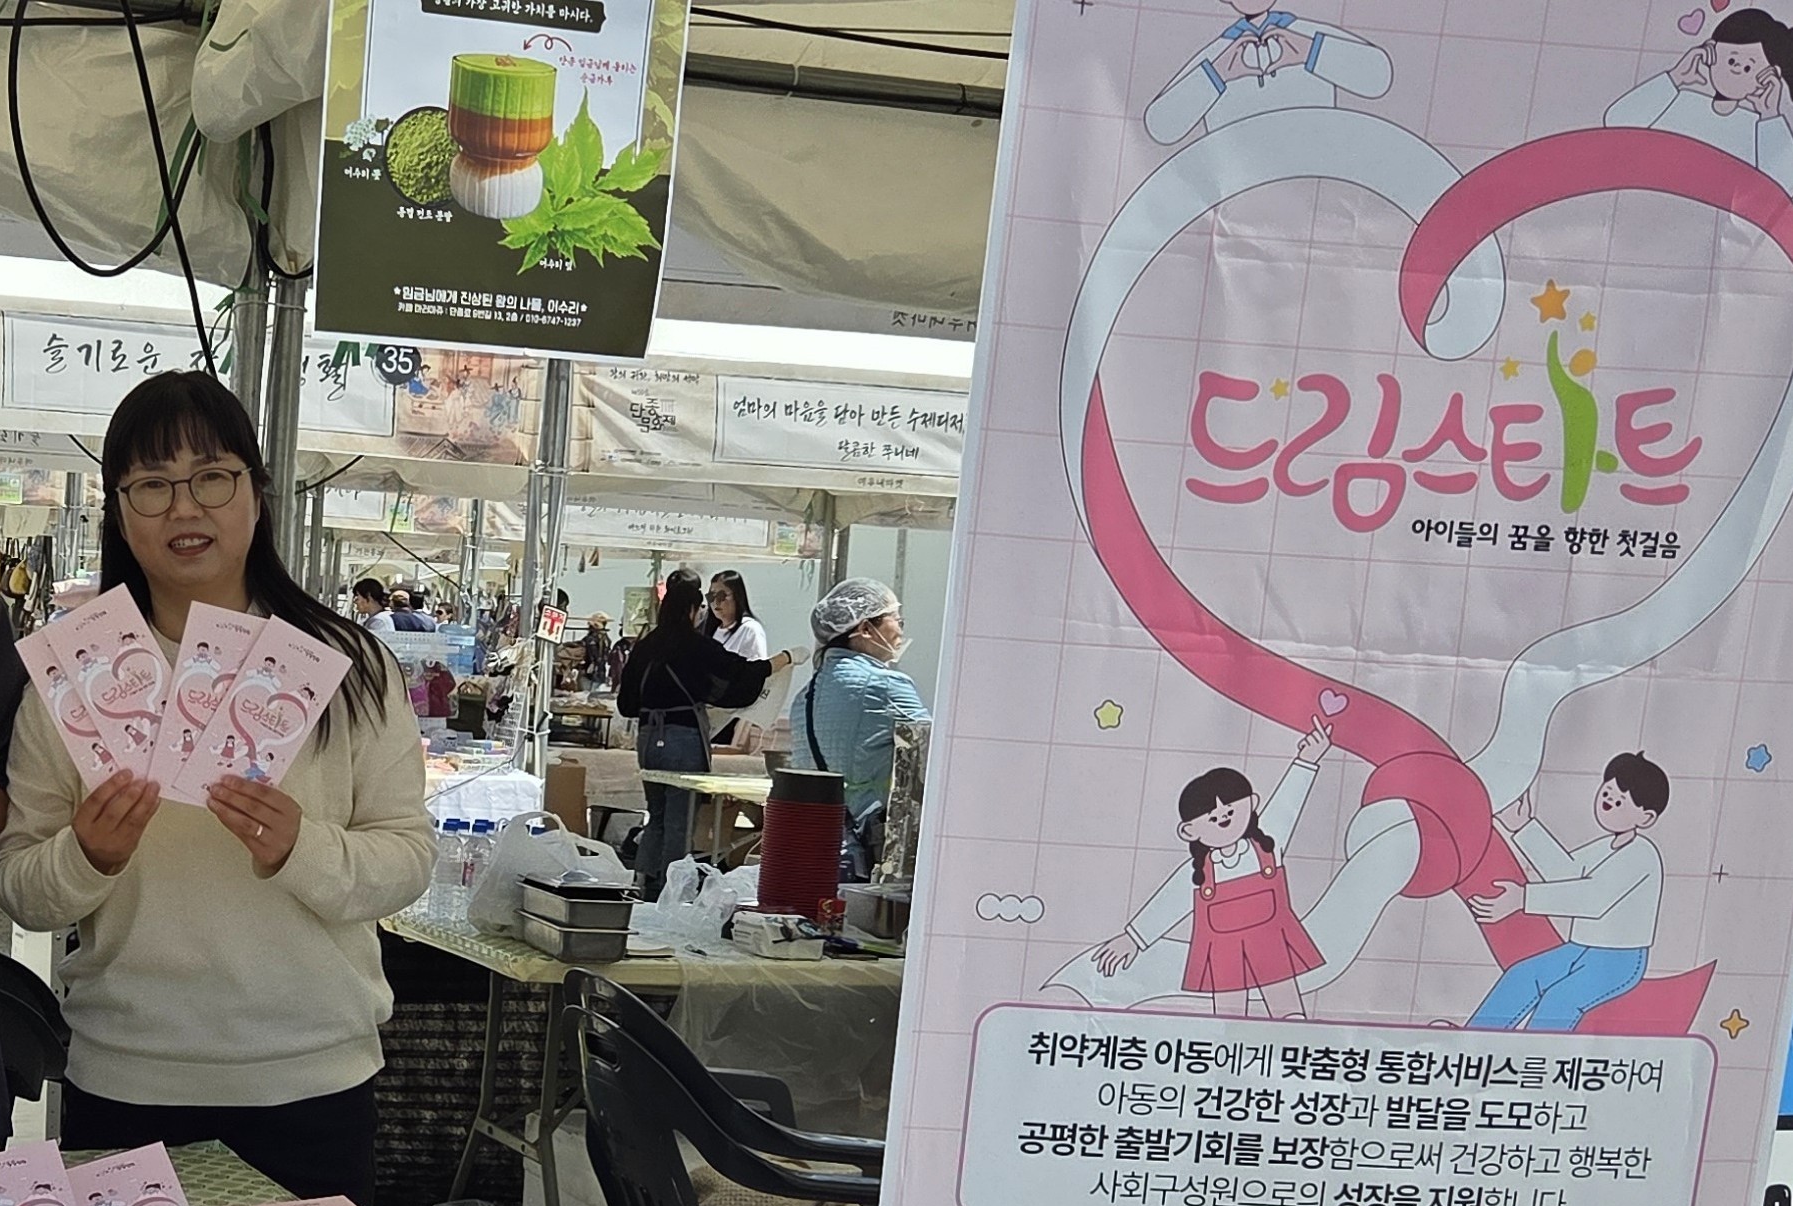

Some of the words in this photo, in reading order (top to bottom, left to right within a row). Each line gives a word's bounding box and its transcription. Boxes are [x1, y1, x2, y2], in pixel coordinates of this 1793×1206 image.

[559, 8, 594, 24] 마시다.
[42, 332, 163, 375] 슬기로운
[380, 344, 415, 375] 35
[732, 395, 777, 421] 엄마의
[784, 399, 829, 428] 마음을
[833, 402, 865, 428] 담아
[871, 405, 902, 430] 만든
[906, 407, 968, 435] 수제디저
[1185, 330, 1703, 532] 드림스타트
[1410, 518, 1498, 547] 아이들의
[1508, 525, 1555, 553] 꿈을
[1563, 527, 1611, 557] 향한
[1616, 530, 1683, 560] 첫걸음
[1028, 1031, 1148, 1073] 취약계층
[1154, 1036, 1274, 1077] 아동에게
[1280, 1041, 1371, 1083] 맞춤형
[1375, 1046, 1545, 1091] 통합서비스를
[1551, 1051, 1664, 1096] 제공하여
[1096, 1081, 1186, 1120] 아동의
[1192, 1086, 1285, 1123] 건강한
[1289, 1090, 1379, 1128] 성장과
[1385, 1094, 1472, 1132] 발달을
[1476, 1098, 1589, 1137] 도모하고
[1017, 1119, 1110, 1158] 공평한
[1113, 1124, 1265, 1167] 출발기회를
[1268, 1132, 1443, 1175] 보장함으로써
[1448, 1138, 1562, 1179] 건강하고
[1567, 1143, 1652, 1183] 행복한
